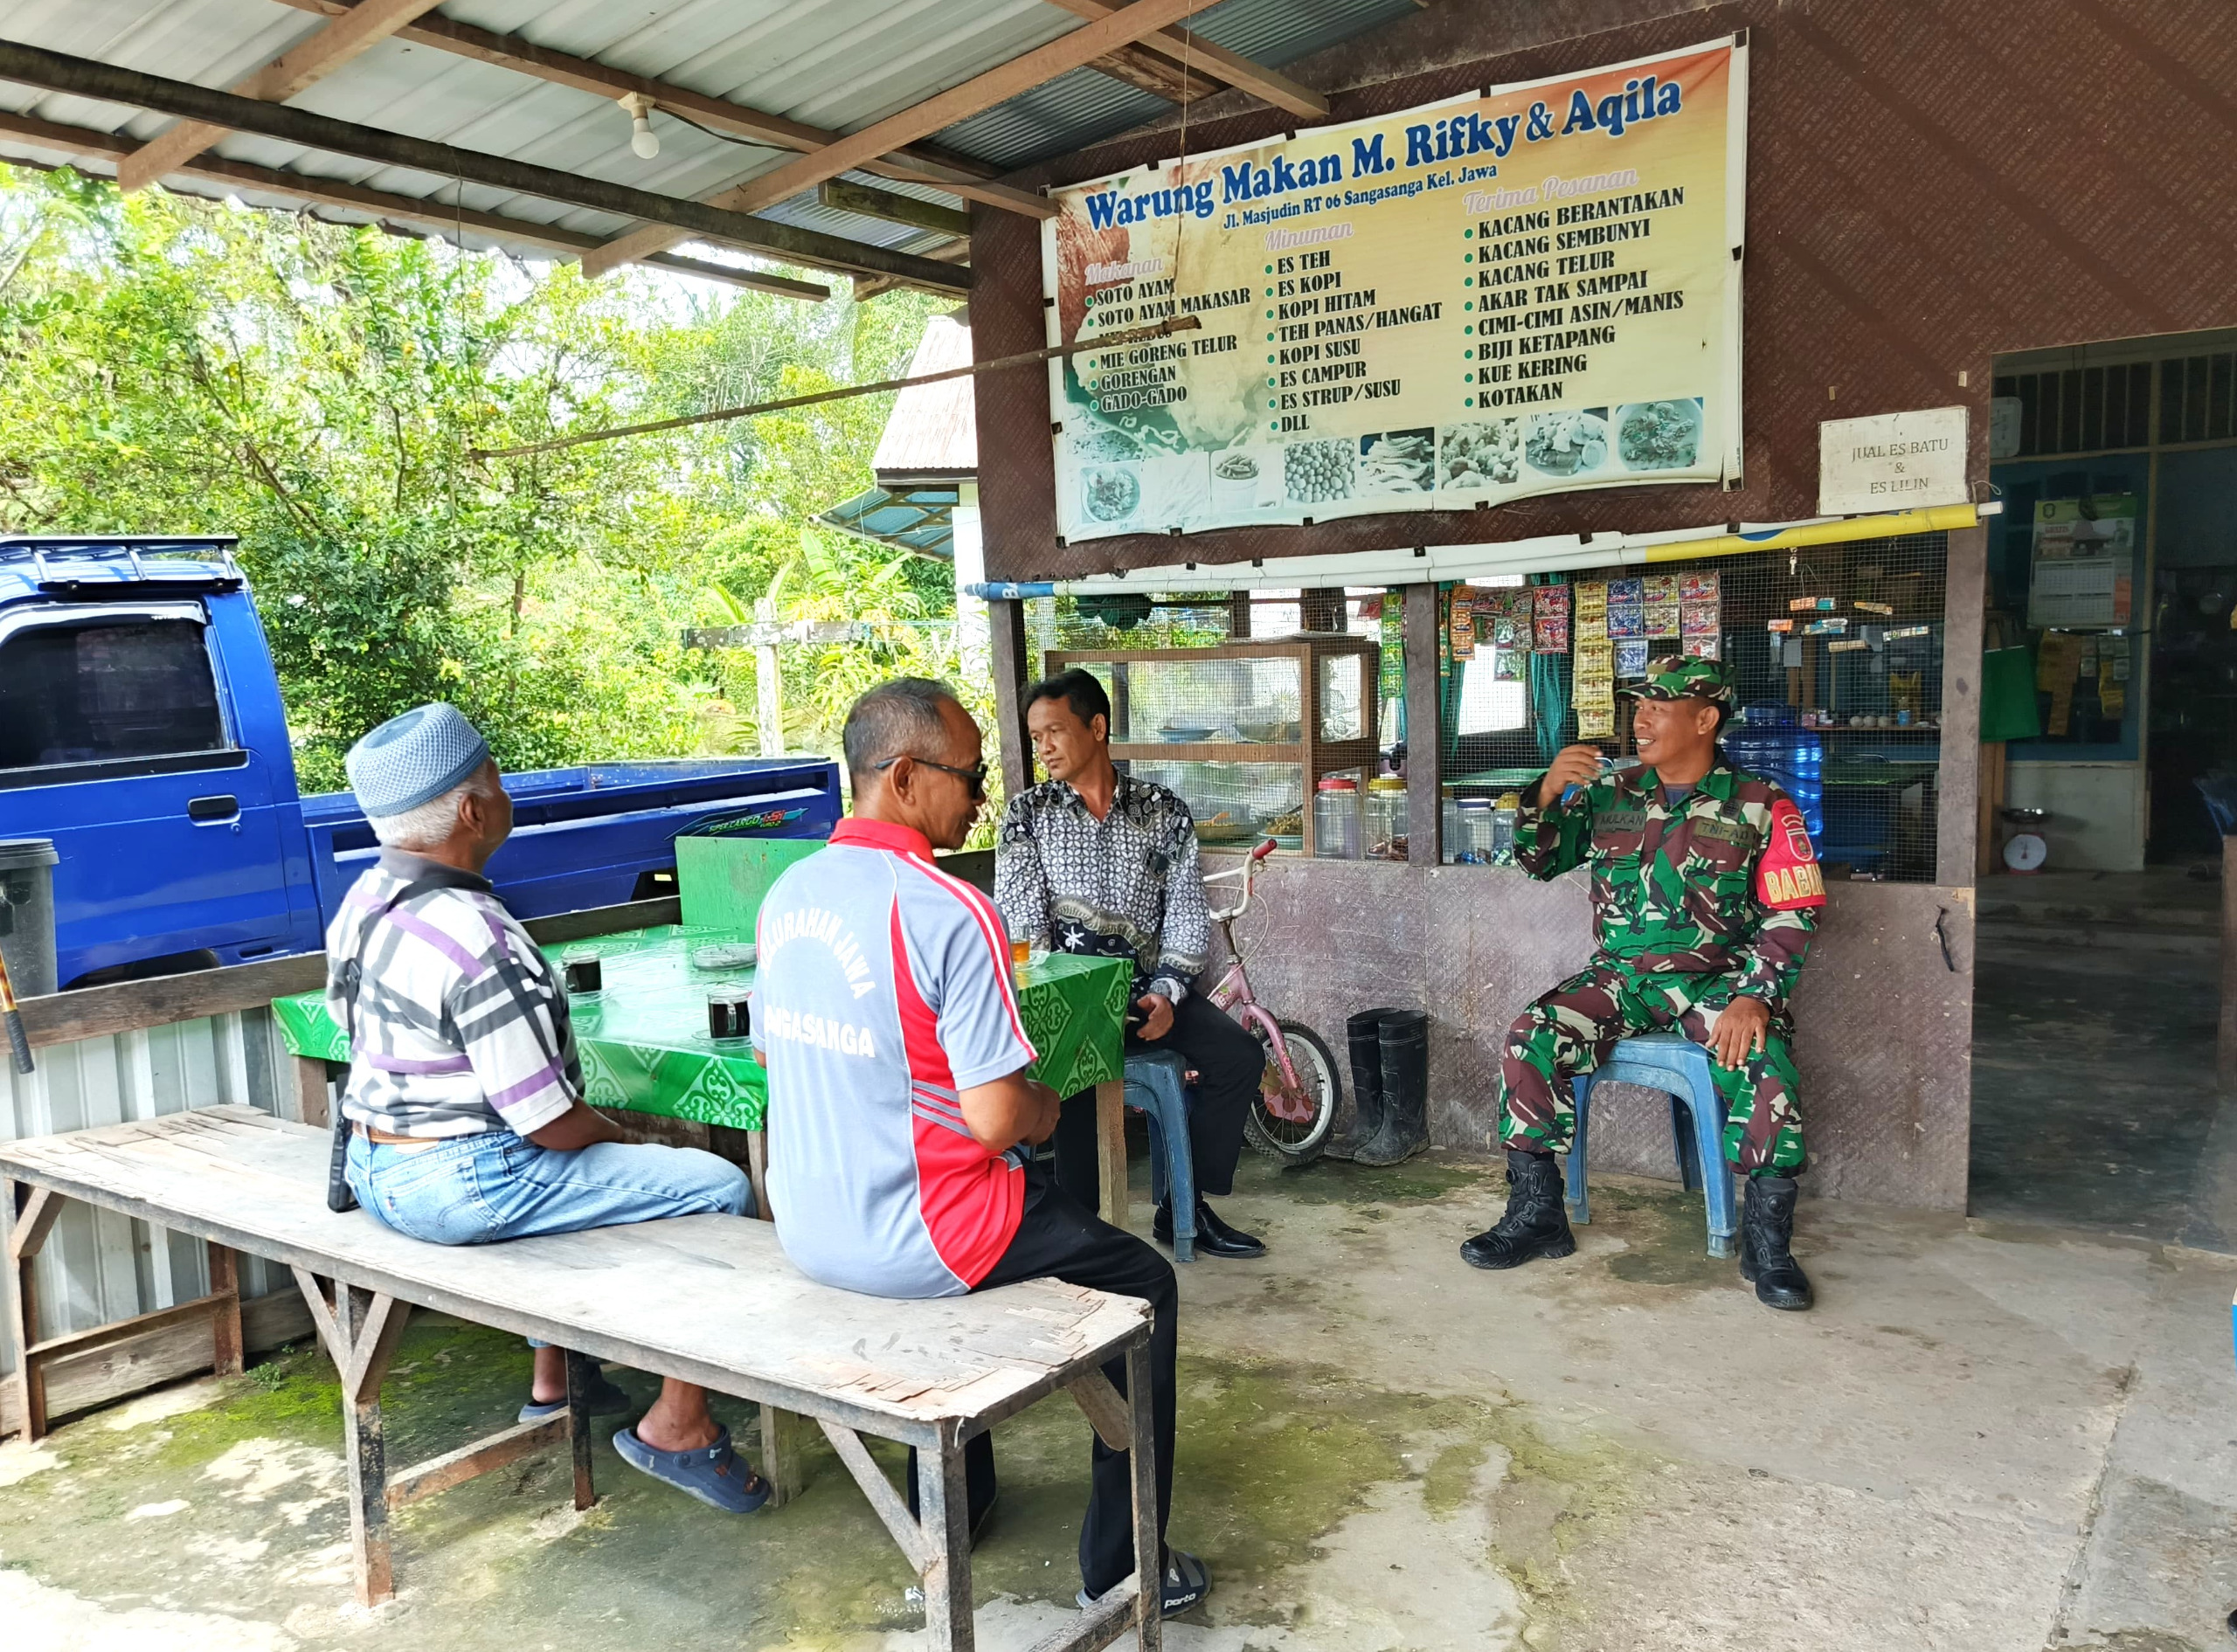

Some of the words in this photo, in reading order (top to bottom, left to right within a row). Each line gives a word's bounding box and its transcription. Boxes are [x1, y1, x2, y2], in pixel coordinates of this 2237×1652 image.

[1085, 176, 1215, 230] Warung
[1222, 154, 1342, 204] Makan
[1352, 134, 1395, 178] M.
[1405, 113, 1521, 166] Rifky
[1526, 102, 1555, 142] &
[1562, 77, 1681, 135] Aqila
[1223, 215, 1239, 229] Jl.
[1243, 201, 1300, 226] Masjudin
[1304, 197, 1322, 212] RT
[1325, 194, 1341, 210] 06
[1344, 179, 1423, 207] Sangasanga
[1427, 173, 1454, 189] Kel.
[1458, 163, 1498, 184] Jawa
[1463, 188, 1539, 215] Terima
[1541, 169, 1639, 201] Pesanan
[1478, 211, 1549, 239] KACANG
[1556, 187, 1685, 226] BERANTAKAN
[1264, 222, 1354, 252] Minuman
[1478, 236, 1549, 264] KACANG
[1556, 218, 1651, 251] SEMBUNYI
[1084, 257, 1163, 286] Makanan
[1277, 256, 1294, 275] ES
[1299, 250, 1330, 271] TEH
[1478, 261, 1549, 288] KACANG
[1556, 251, 1615, 276] TELUR
[1097, 287, 1133, 306] SOTO
[1138, 278, 1174, 300] AYAM
[1278, 279, 1295, 298] ES
[1299, 272, 1341, 294] KOPI
[1478, 289, 1528, 313] AKAR
[1534, 282, 1570, 304] TAK
[1576, 270, 1648, 298] SAMPAI
[1098, 308, 1134, 328] SOTO
[1139, 300, 1175, 321] AYAM
[1181, 287, 1250, 314] MAKASAR
[1278, 299, 1319, 321] KOPI
[1325, 289, 1376, 313] HITAM
[1478, 308, 1564, 336] CIMI-CIMI
[1569, 290, 1684, 324] ASIN/MANIS
[1278, 323, 1309, 342] TEH
[1314, 301, 1443, 337] PANAS/HANGAT
[1099, 353, 1125, 370] MIE
[1129, 342, 1188, 366] GORENG
[1191, 335, 1237, 356] TELUR
[1279, 344, 1319, 365] KOPI
[1326, 338, 1361, 359] SUSU
[1478, 340, 1513, 361] BIJI
[1519, 326, 1616, 356] KETAPANG
[1101, 366, 1176, 391] GORENGAN
[1280, 370, 1297, 388] ES
[1302, 361, 1367, 385] CAMPUR
[1478, 364, 1512, 385] KUE
[1518, 354, 1587, 380] KERING
[1102, 386, 1188, 411] GADO-GADO
[1280, 393, 1298, 411] ES
[1302, 378, 1401, 408] STRUP/SUSU
[1478, 382, 1563, 409] KOTAKAN
[1281, 414, 1310, 432] DLL
[1852, 446, 1885, 463] JUAL
[1889, 443, 1906, 456] ES
[1910, 439, 1950, 454] BATU
[1894, 461, 1905, 473] &
[1870, 482, 1887, 494] ES
[1891, 478, 1929, 493] LILIN
[730, 815, 760, 827] CARGO
[1702, 823, 1749, 840] TNI-AD
[833, 930, 876, 1000] JAWA
